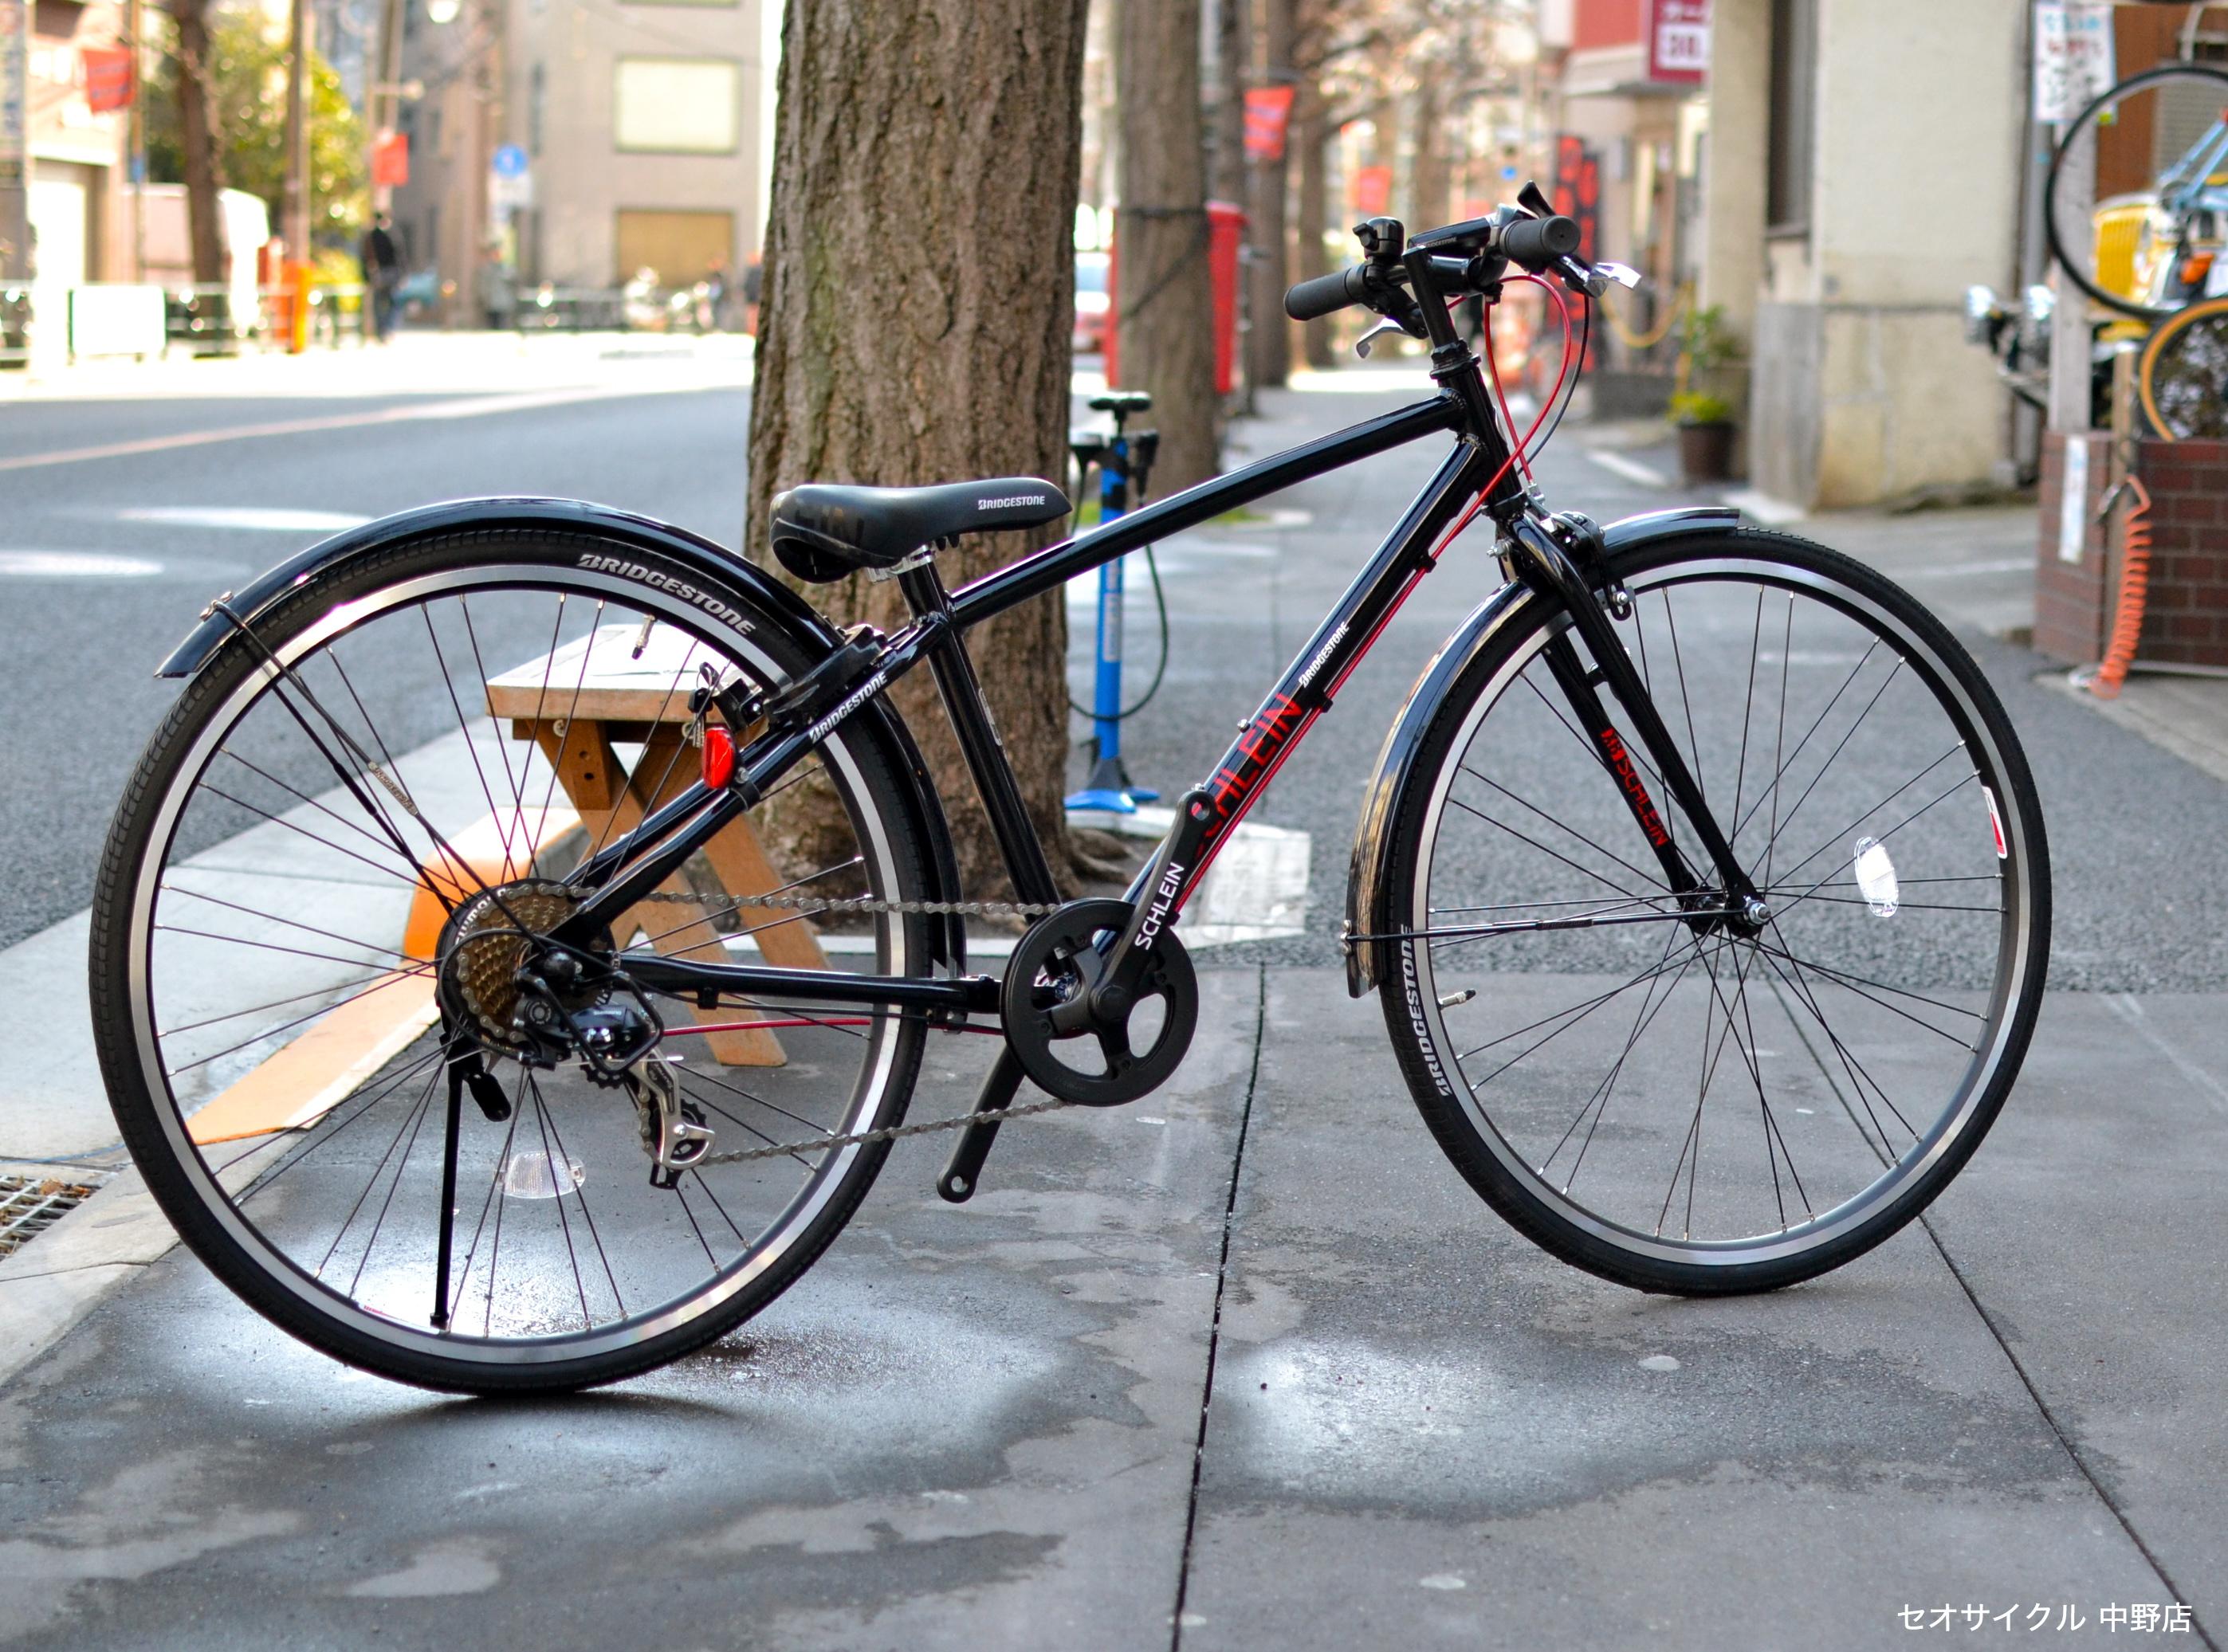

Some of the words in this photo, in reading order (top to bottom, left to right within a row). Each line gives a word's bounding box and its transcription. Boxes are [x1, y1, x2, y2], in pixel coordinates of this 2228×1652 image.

[977, 495, 1046, 510] BRIDGESTONE
[576, 554, 756, 635] BRIDGESTONE
[1298, 621, 1350, 689] BRIDGESTONE
[808, 671, 888, 744] BRIDGESTONE
[1134, 861, 1185, 951] SCHLEIN
